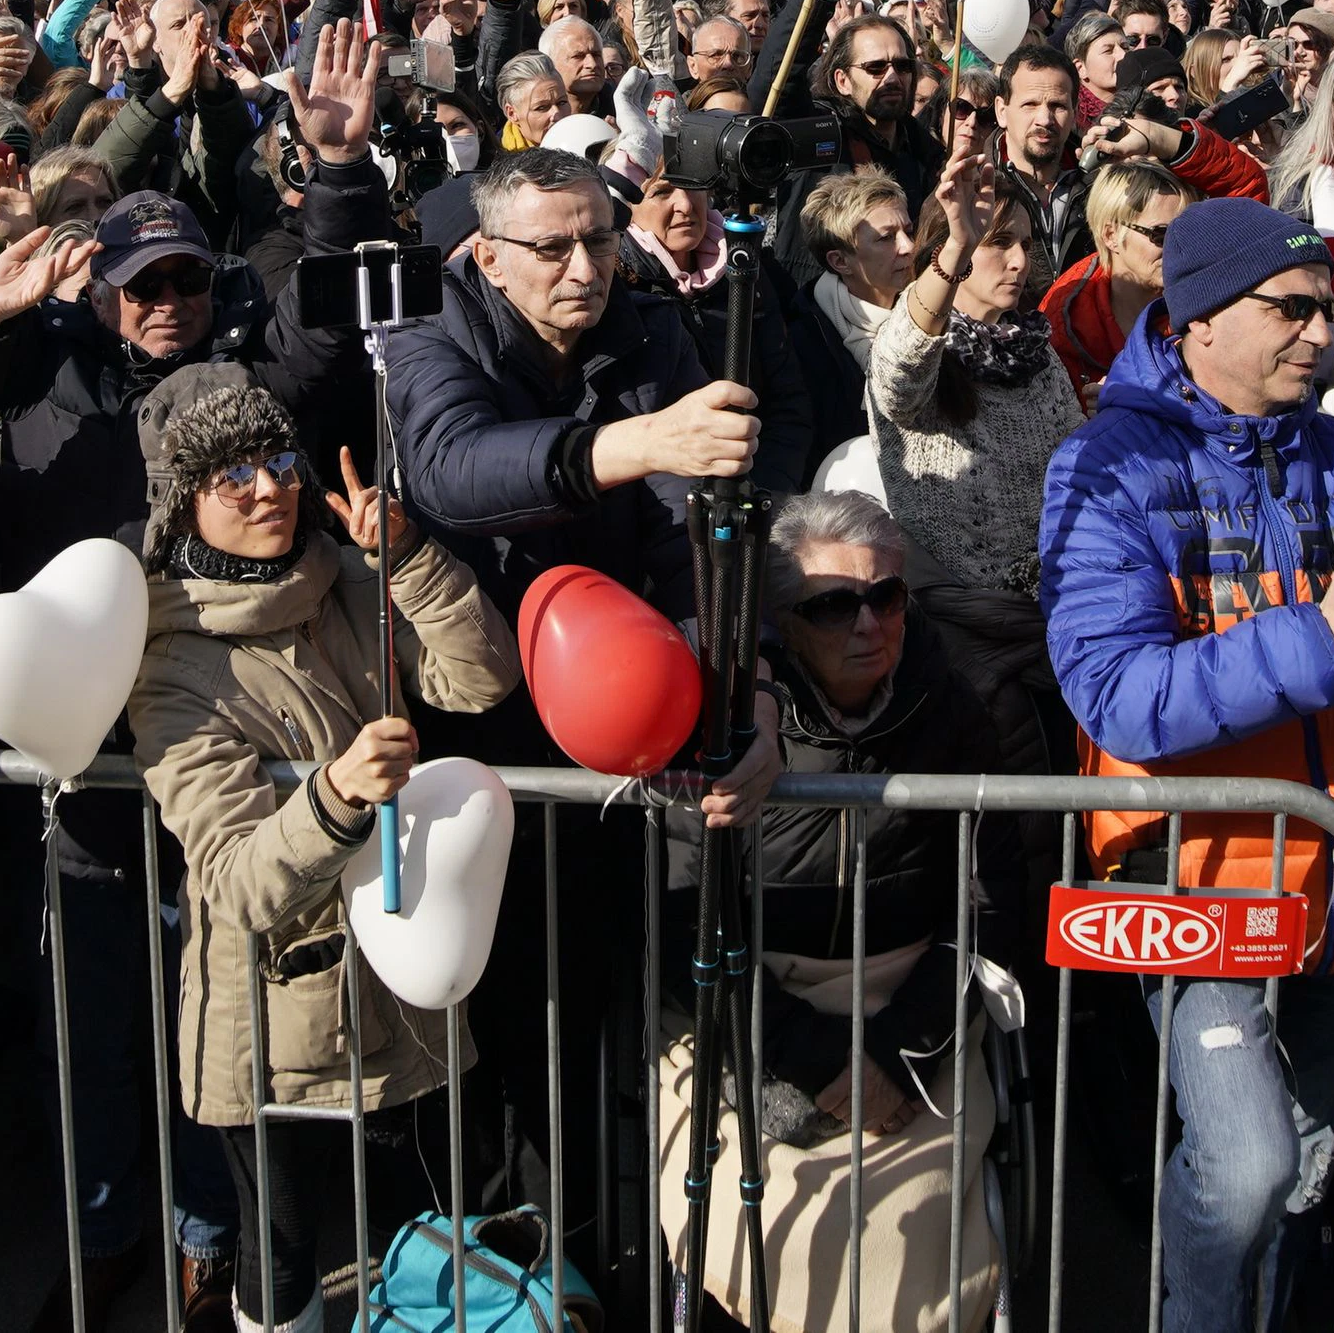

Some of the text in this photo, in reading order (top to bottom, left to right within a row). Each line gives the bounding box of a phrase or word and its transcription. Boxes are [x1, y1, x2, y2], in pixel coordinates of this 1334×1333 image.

[815, 121, 833, 129] SONY
[1286, 235, 1308, 249] CAMP
[1069, 907, 1209, 959] EKRO
[1247, 944, 1267, 952] 3855
[1268, 944, 1288, 952] 2631
[1234, 954, 1282, 963] www.ekro.at
